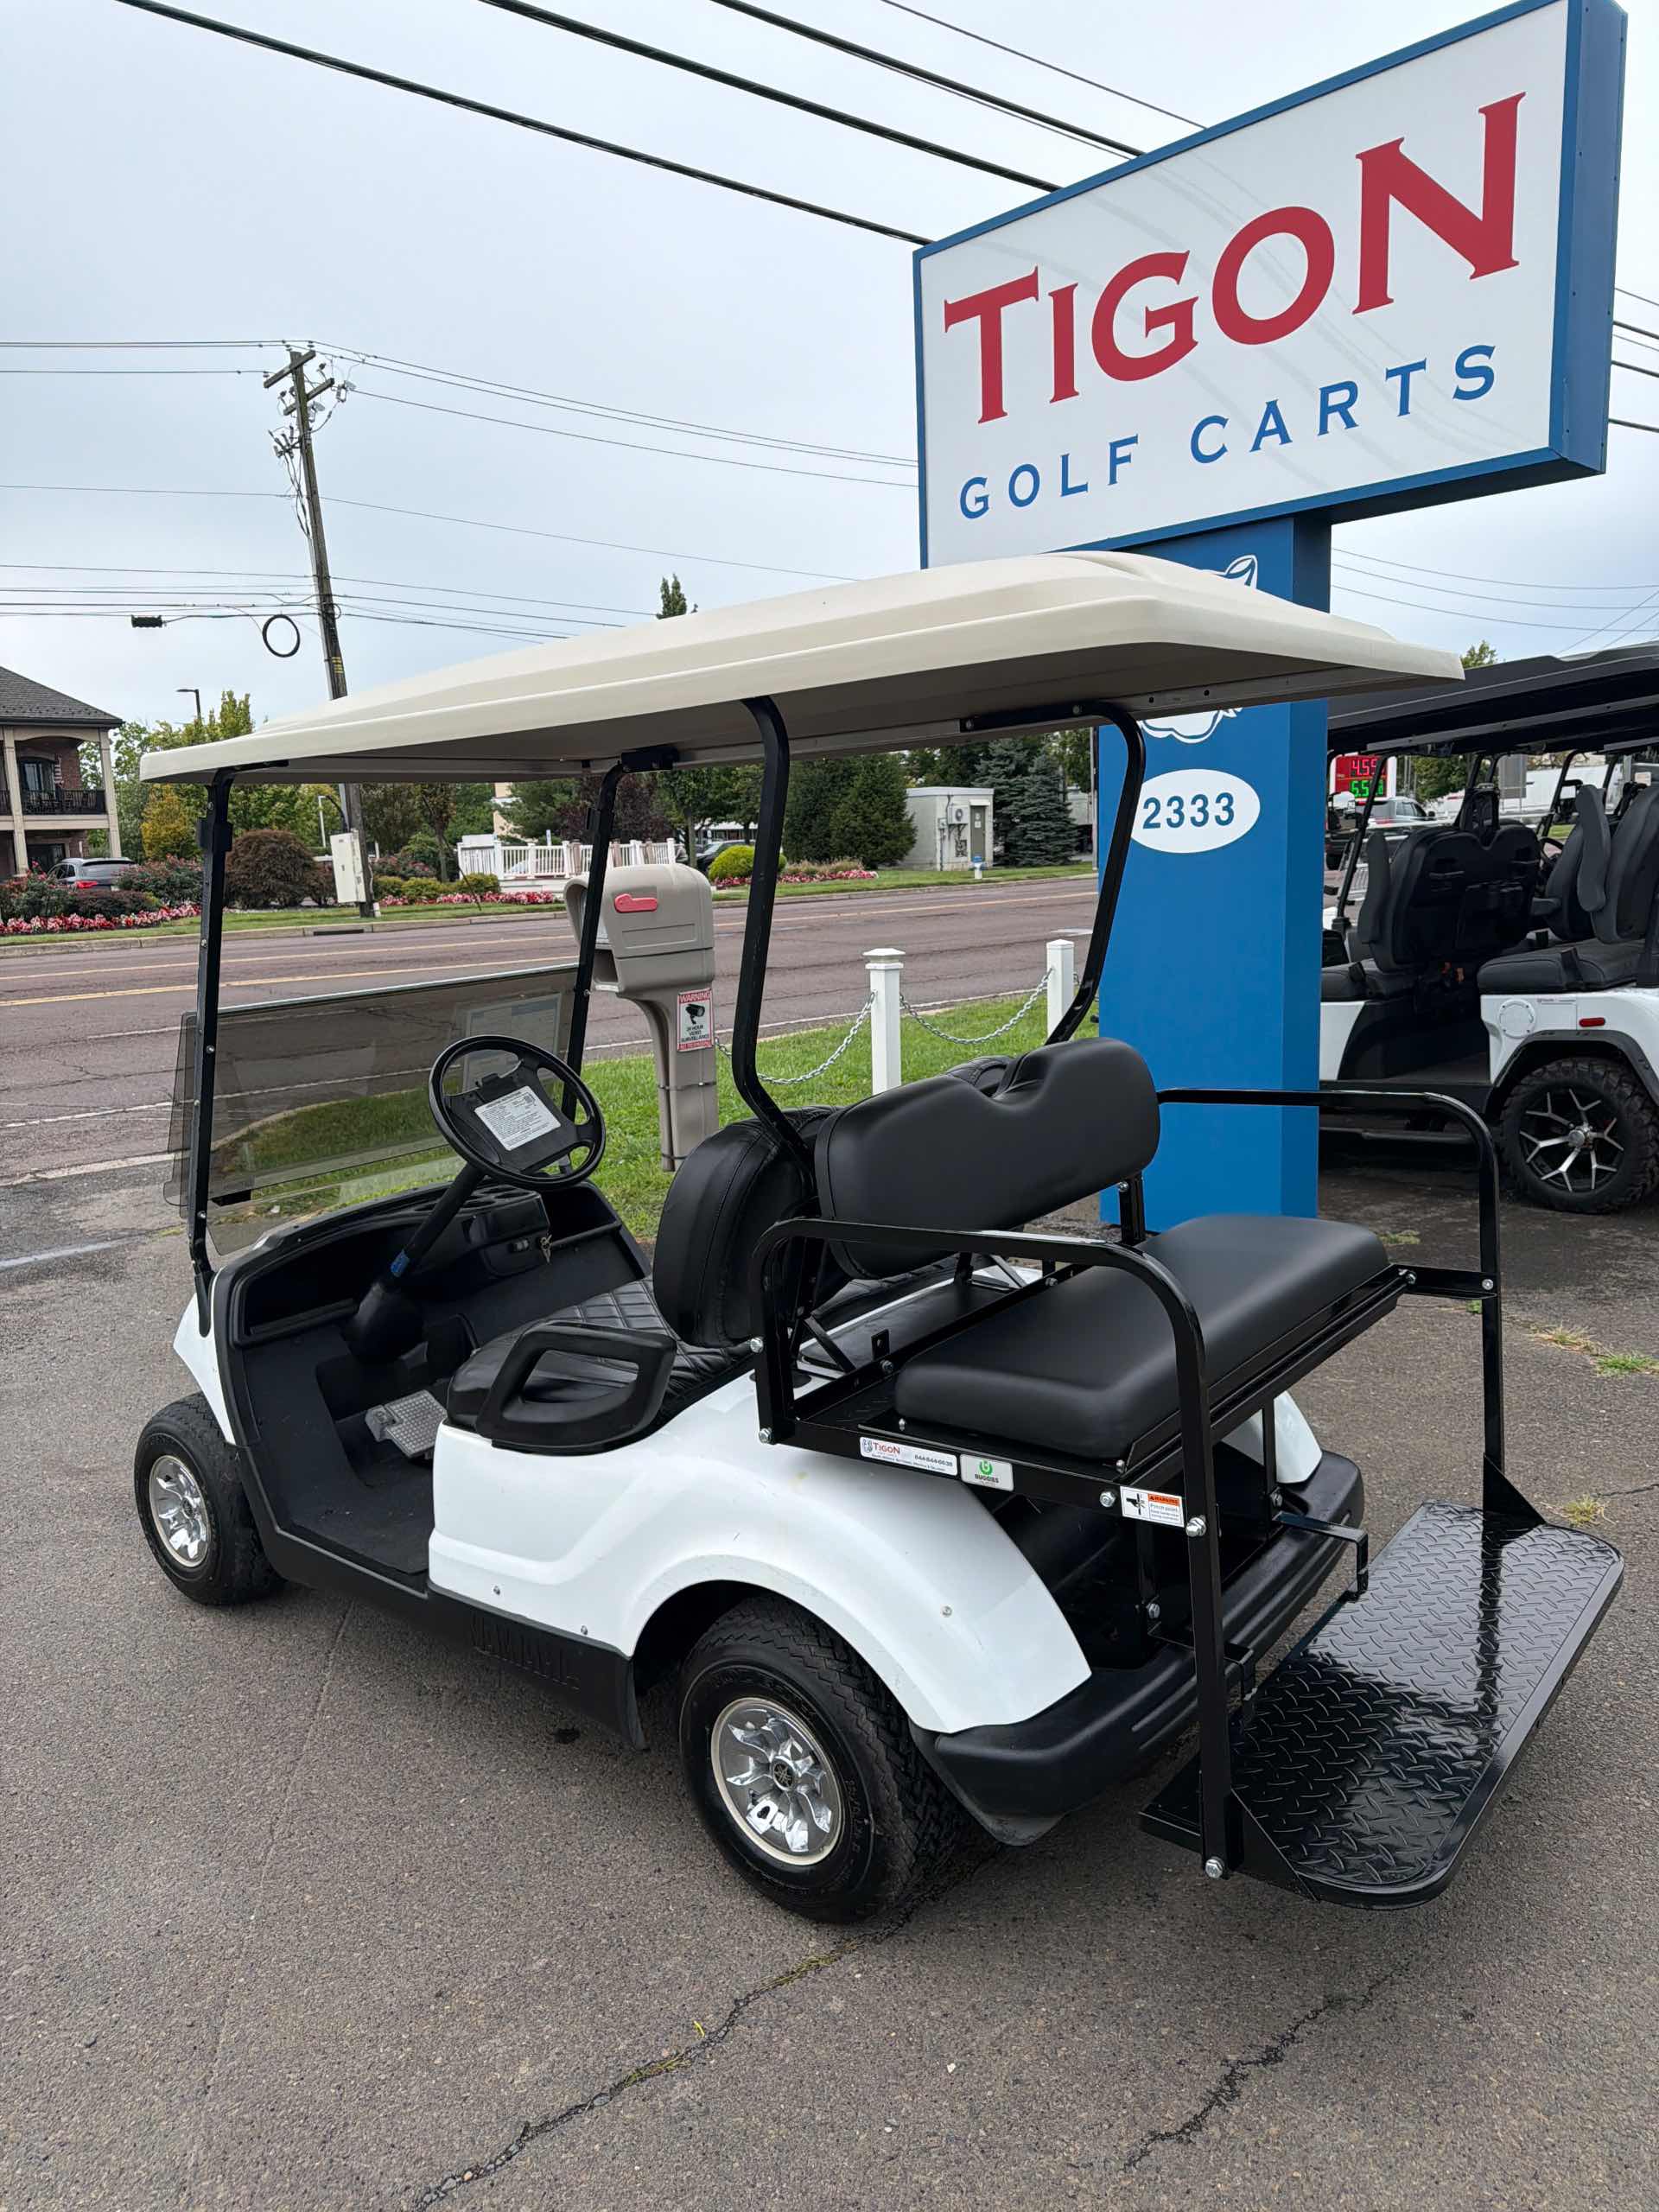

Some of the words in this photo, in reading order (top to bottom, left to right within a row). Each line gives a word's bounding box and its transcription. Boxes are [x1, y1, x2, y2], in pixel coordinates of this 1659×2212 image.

[944, 92, 1527, 423] TIGON
[960, 435, 1138, 518] GOLF
[1190, 346, 1496, 464] CARTS
[1143, 792, 1234, 829] 2333
[680, 992, 710, 1002] WARNING
[873, 1441, 900, 1454] TIGON
